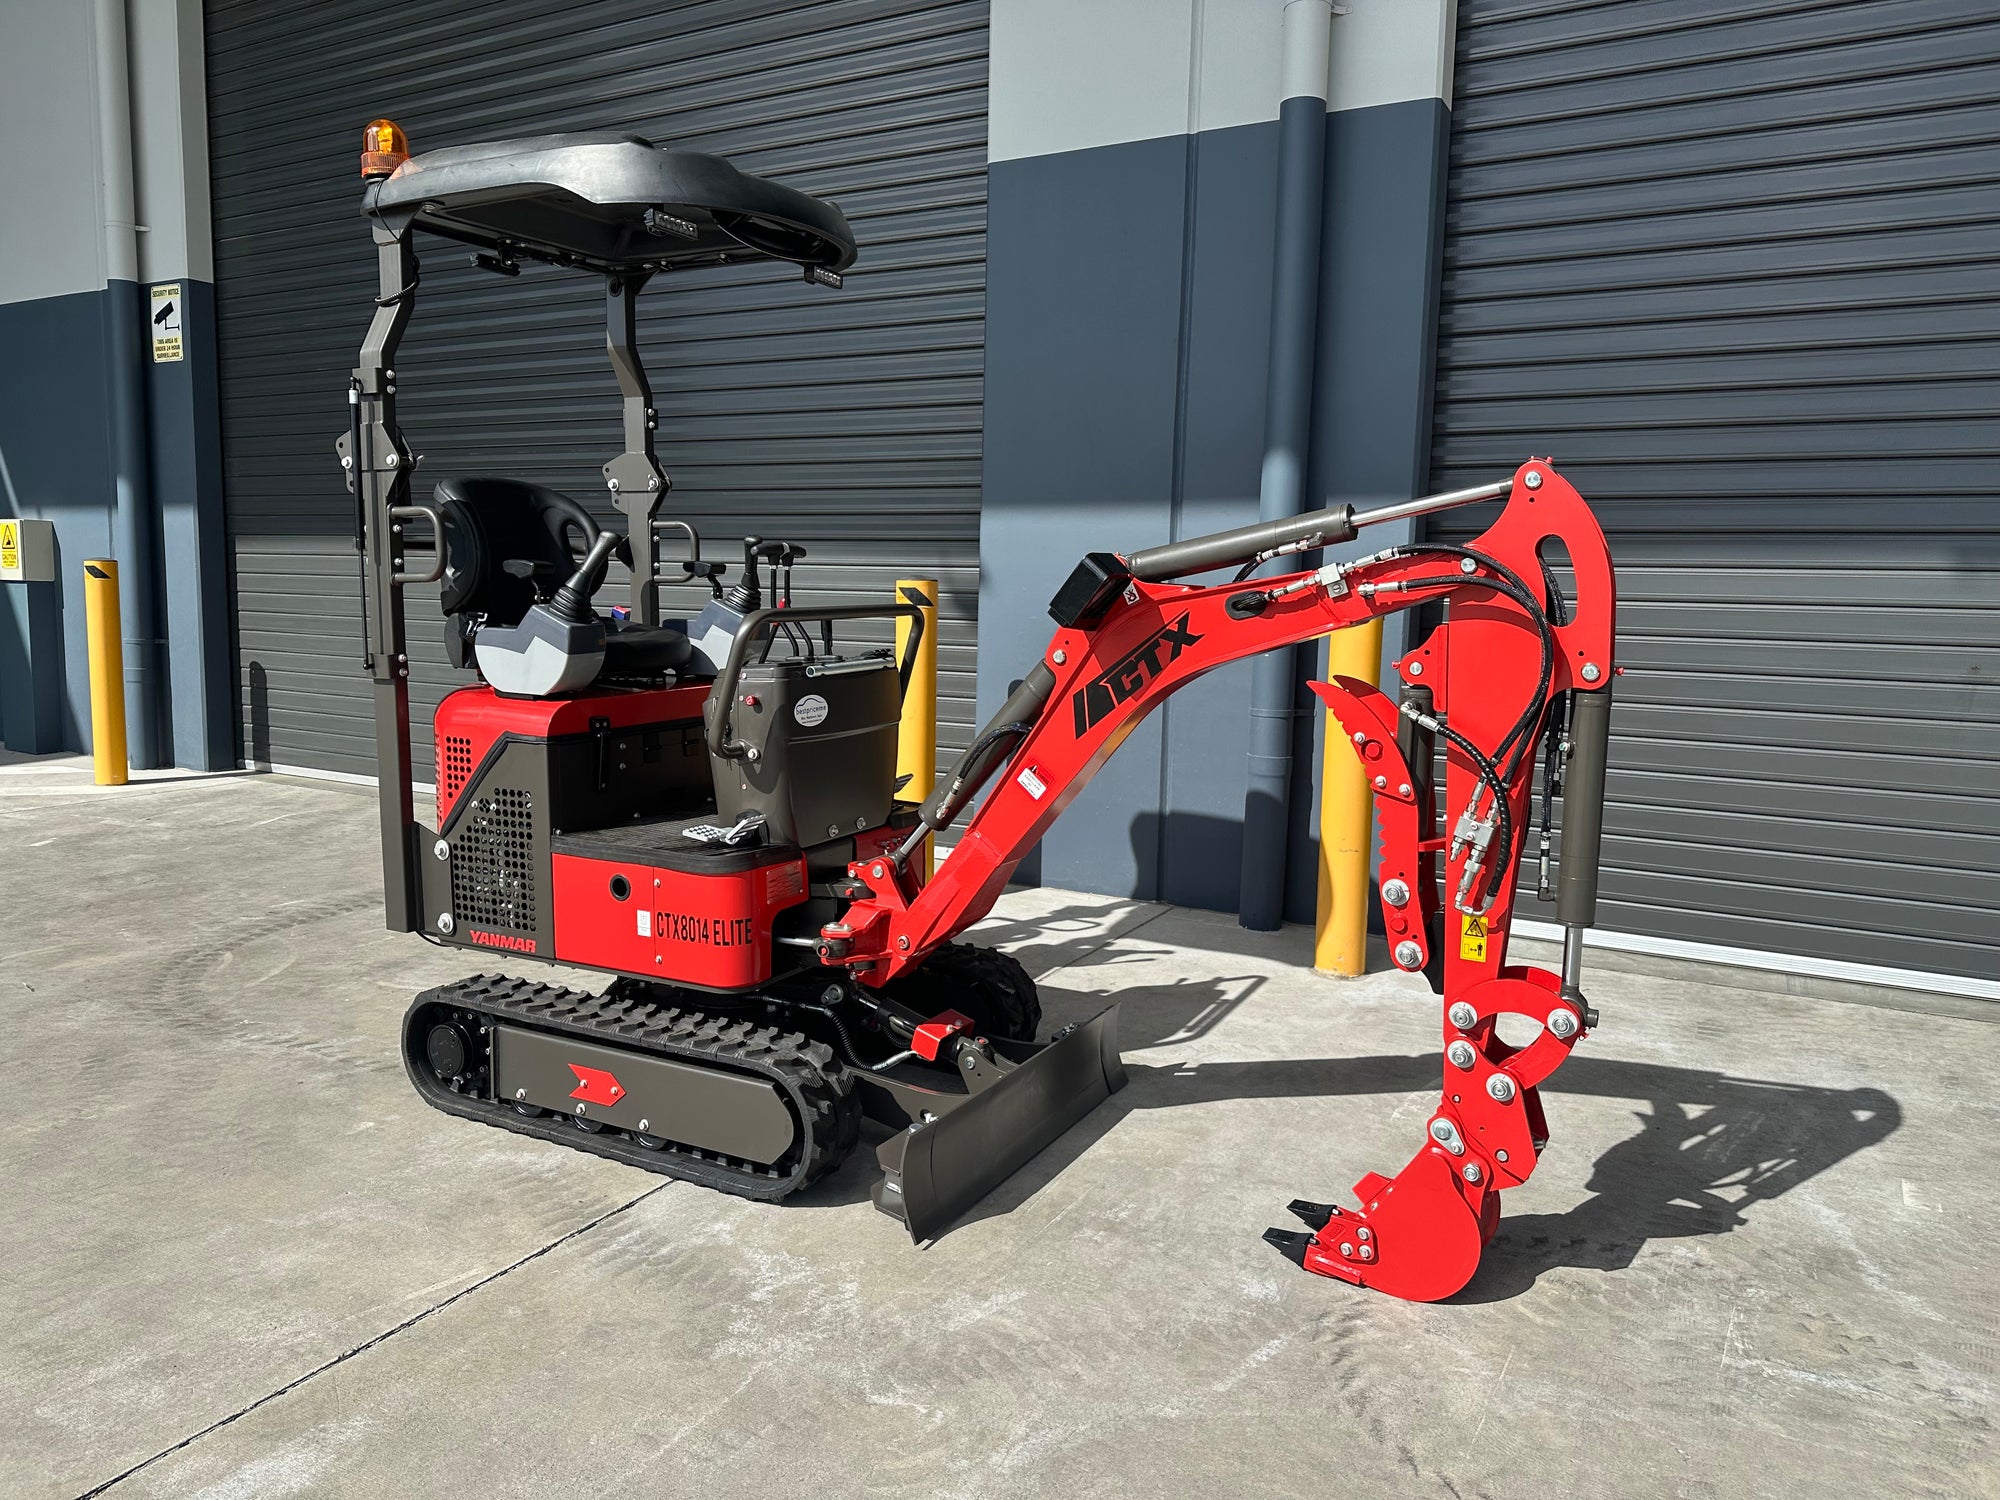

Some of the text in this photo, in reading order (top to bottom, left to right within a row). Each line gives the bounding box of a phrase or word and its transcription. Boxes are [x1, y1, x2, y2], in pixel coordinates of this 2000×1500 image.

[152, 288, 180, 298] SECURITY NOTICE
[156, 351, 180, 359] SURVEILLANCE
[1104, 611, 1206, 706] CTX
[469, 929, 537, 954] YANMAR
[656, 911, 753, 947] CTX8014 ELITE
